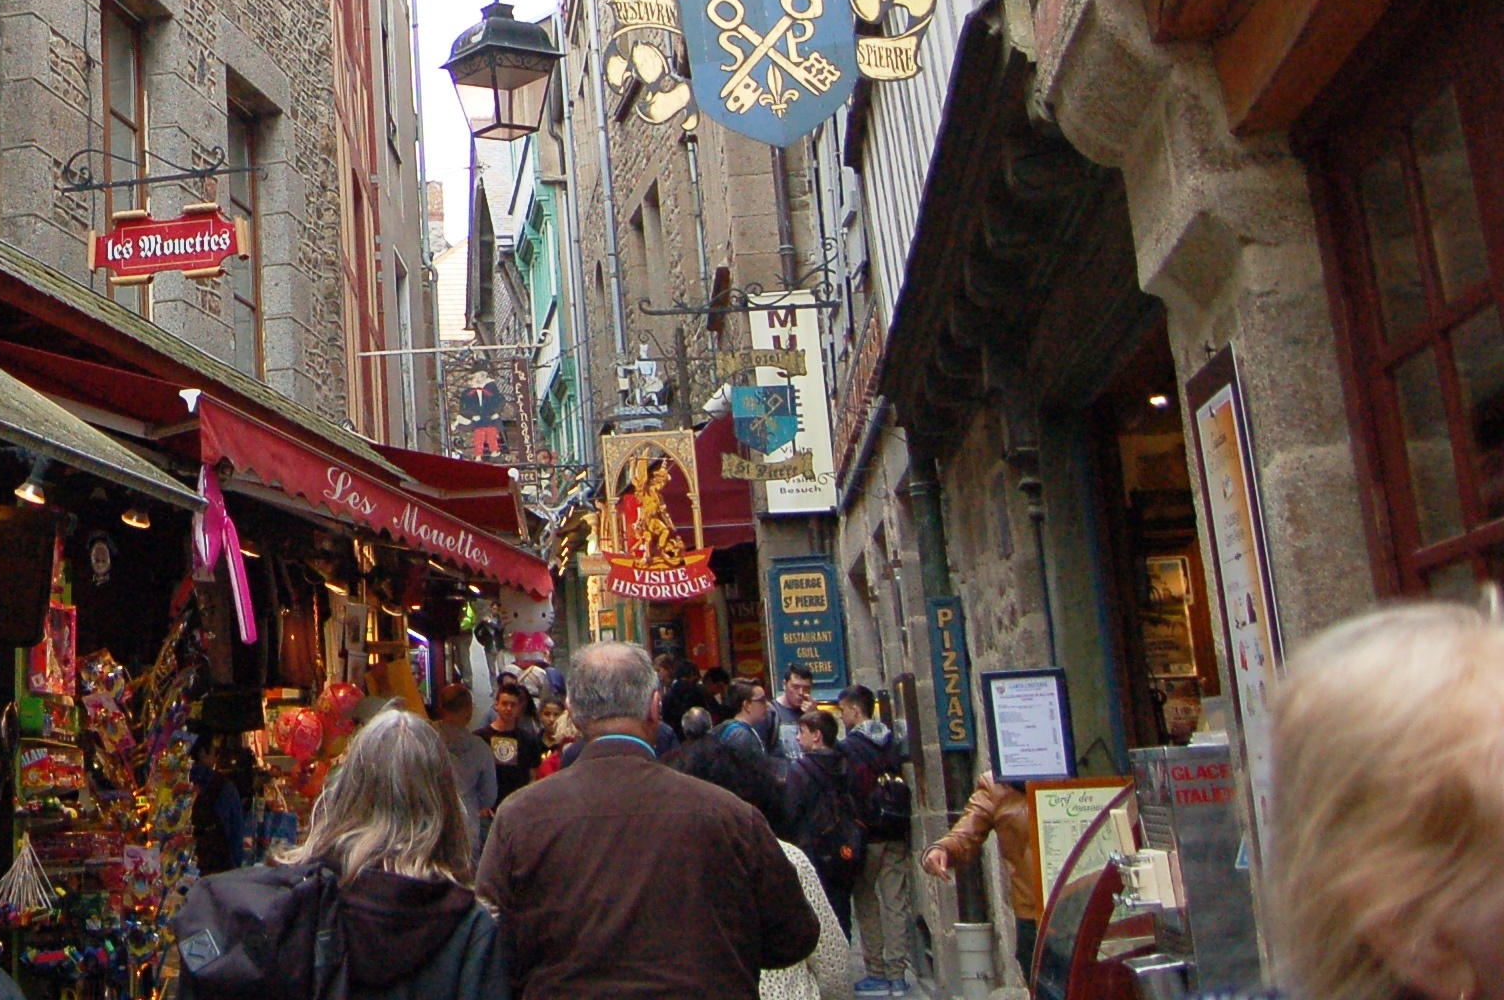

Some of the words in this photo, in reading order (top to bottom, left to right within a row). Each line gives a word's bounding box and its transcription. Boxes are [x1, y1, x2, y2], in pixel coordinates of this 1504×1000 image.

[107, 237, 134, 261] les
[138, 227, 232, 259] Mouettes
[779, 485, 822, 495] Besuch
[322, 466, 377, 515] Les
[392, 502, 493, 566] Mouettes
[633, 567, 689, 584] VISITE
[611, 576, 711, 599] HISTORIQUE
[783, 577, 823, 590] AUBERGE
[795, 594, 826, 608] PIERRE
[783, 630, 832, 644] RESTAURANT
[796, 646, 820, 659] GRILL
[936, 608, 967, 742] PIZZAS
